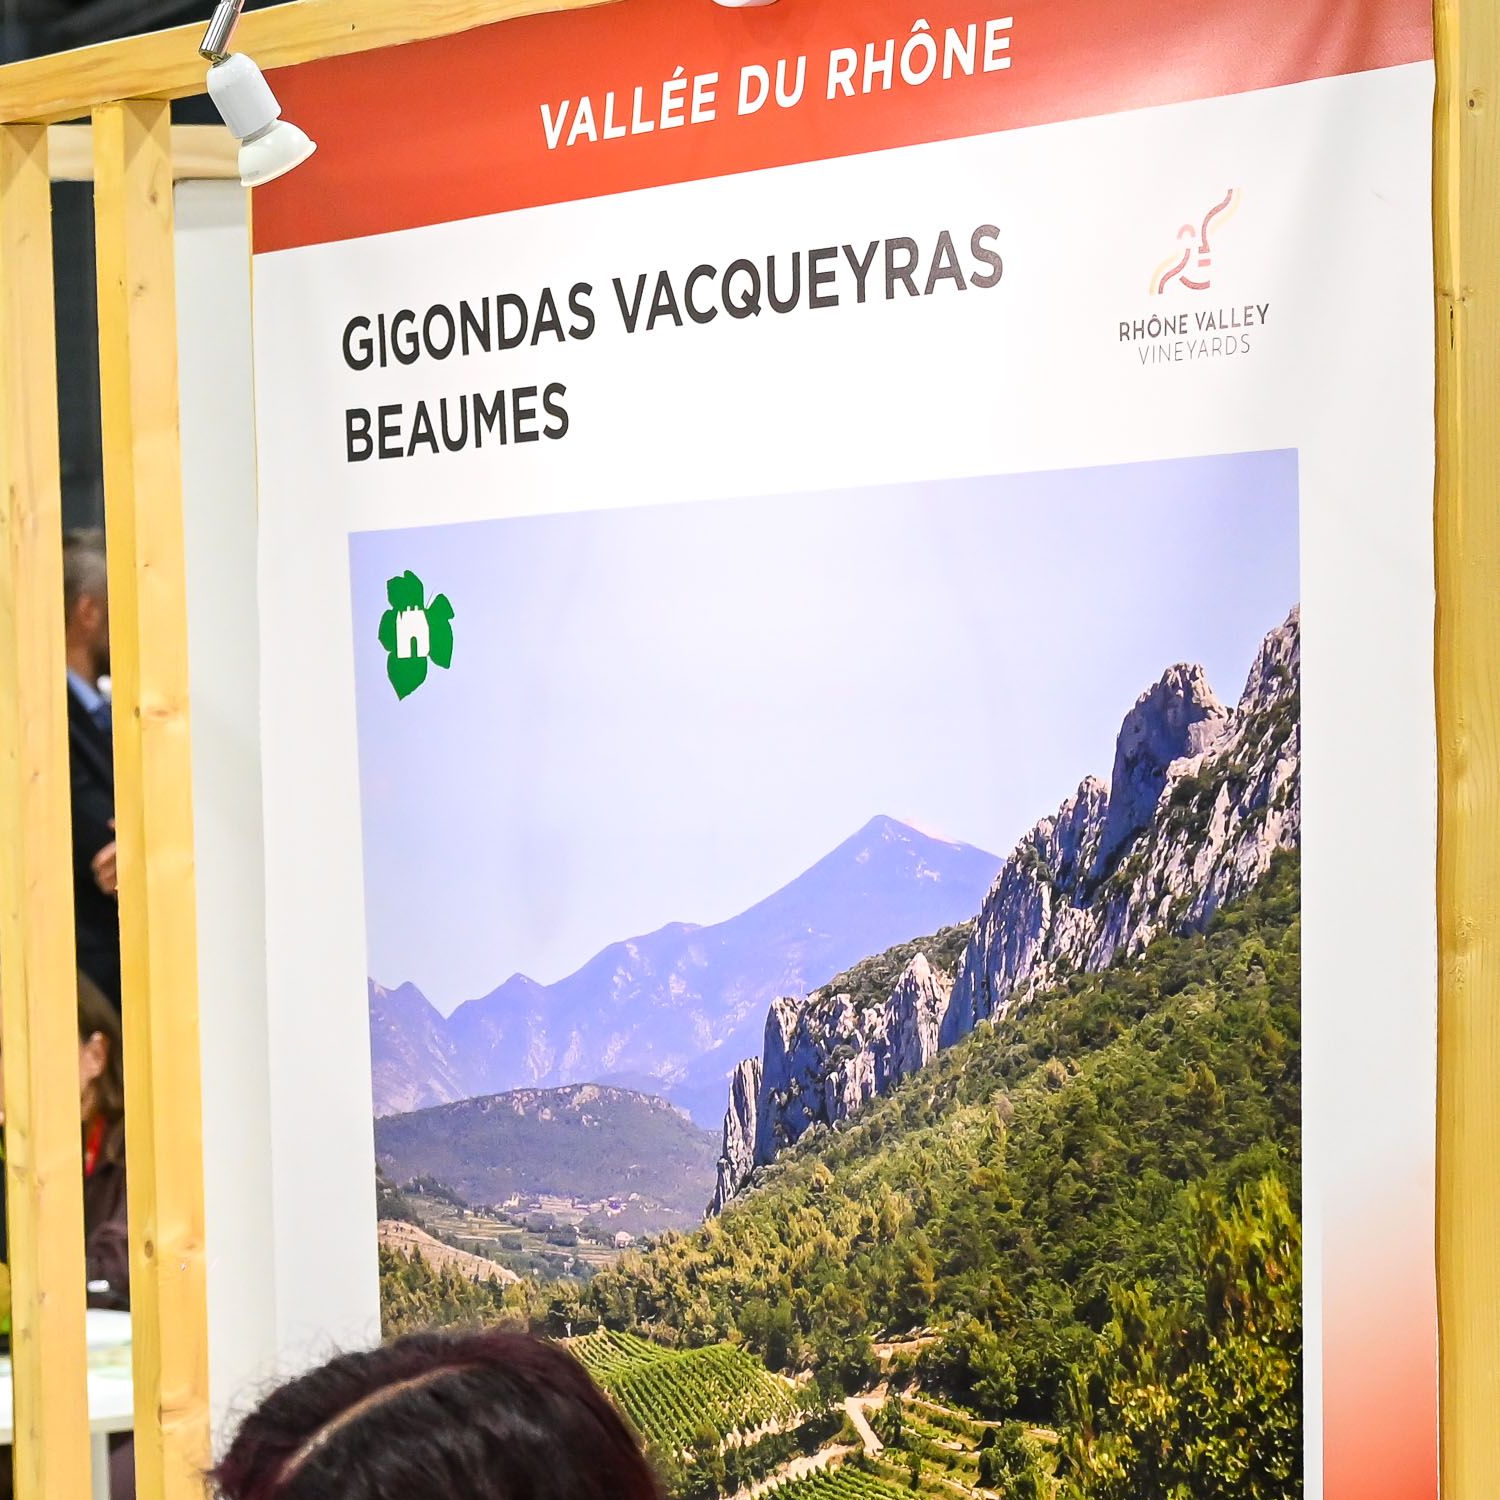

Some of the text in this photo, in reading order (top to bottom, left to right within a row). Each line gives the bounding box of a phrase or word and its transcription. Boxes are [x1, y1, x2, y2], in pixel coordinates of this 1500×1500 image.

[539, 17, 1013, 150] VALLÉE DU RHÔNE
[341, 224, 1004, 370] GIGONDAS VACQUEYRAS
[1118, 302, 1270, 344] RHÔNE VALLEY
[1136, 330, 1252, 365] VINEYARDS
[344, 382, 570, 463] BEAUMES
